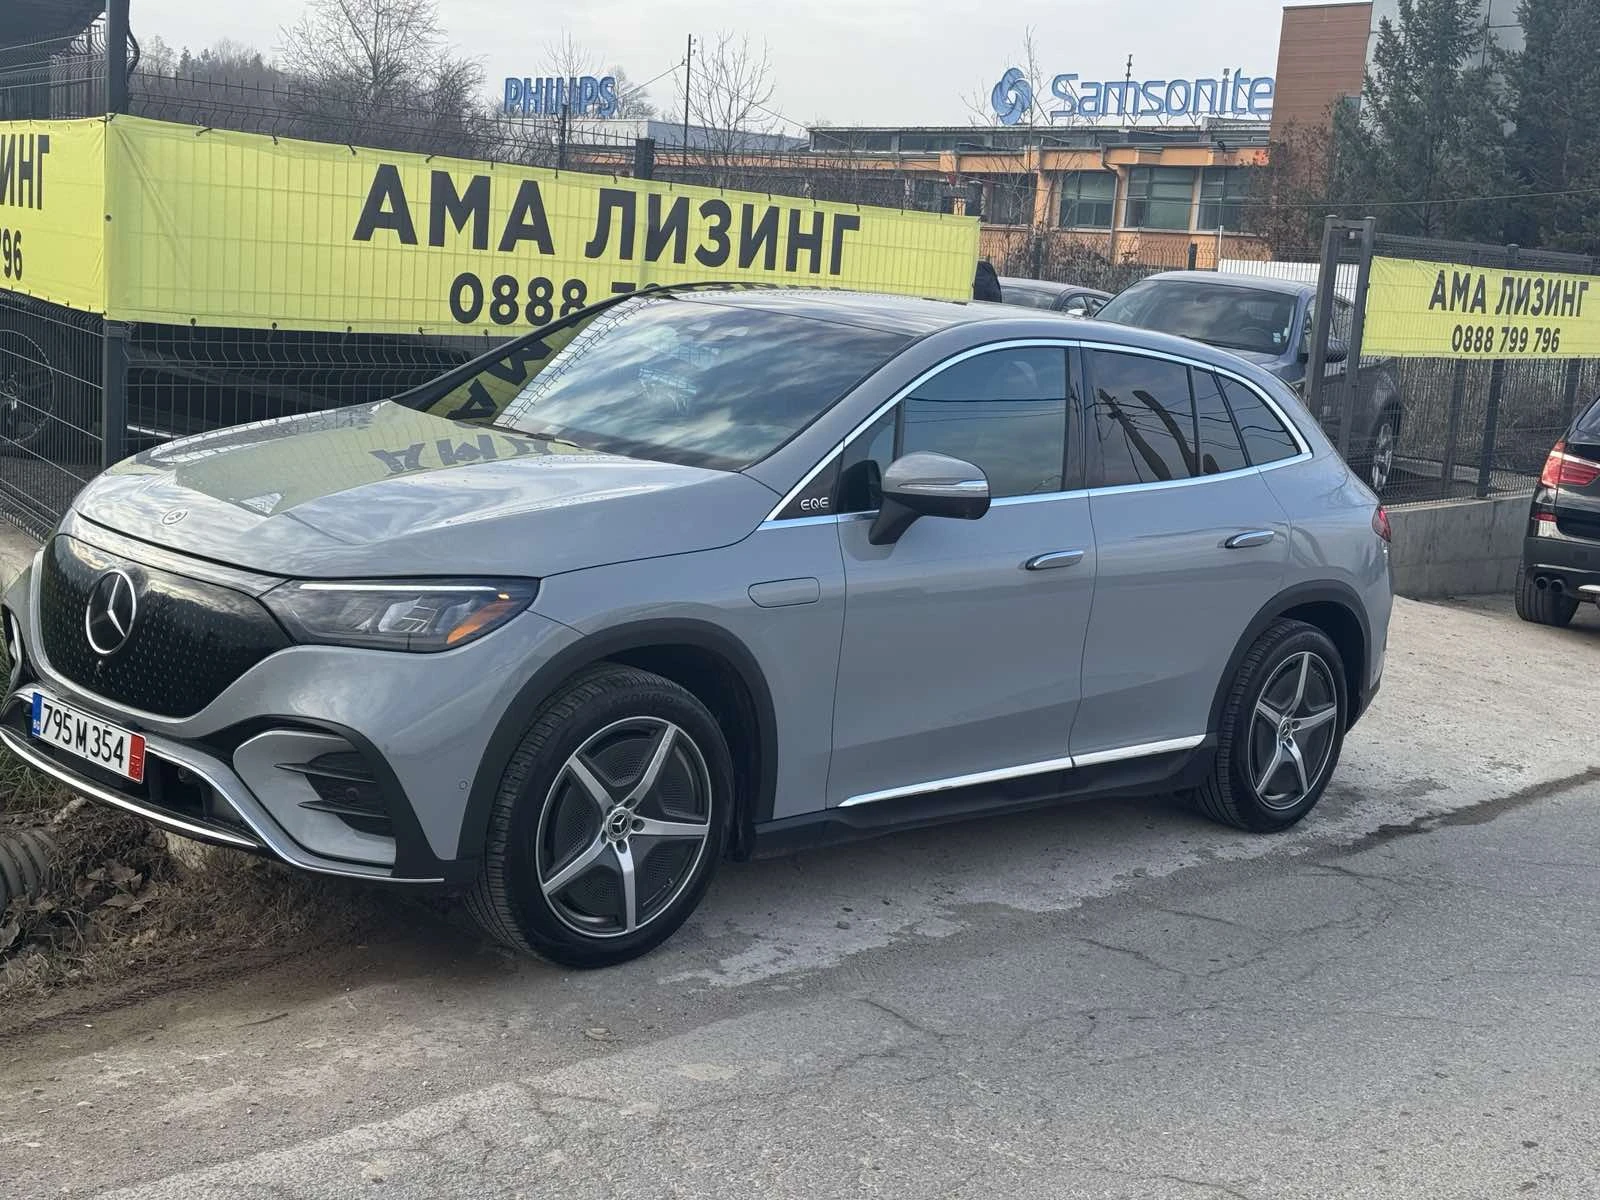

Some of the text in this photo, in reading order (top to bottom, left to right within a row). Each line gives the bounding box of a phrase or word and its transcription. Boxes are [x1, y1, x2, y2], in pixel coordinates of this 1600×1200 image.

[504, 76, 618, 117] PHILIPS
[1051, 68, 1275, 117] Samsonite
[352, 163, 860, 276] АМА ЛИЗИНГ
[0, 228, 23, 280] 96
[449, 272, 588, 326] 0888
[1428, 269, 1589, 317] АМА ЛИЗИНГ
[1452, 324, 1561, 353] 0888 799 796
[800, 496, 829, 511] EQE
[42, 703, 72, 745] 795
[90, 725, 124, 769] 354
